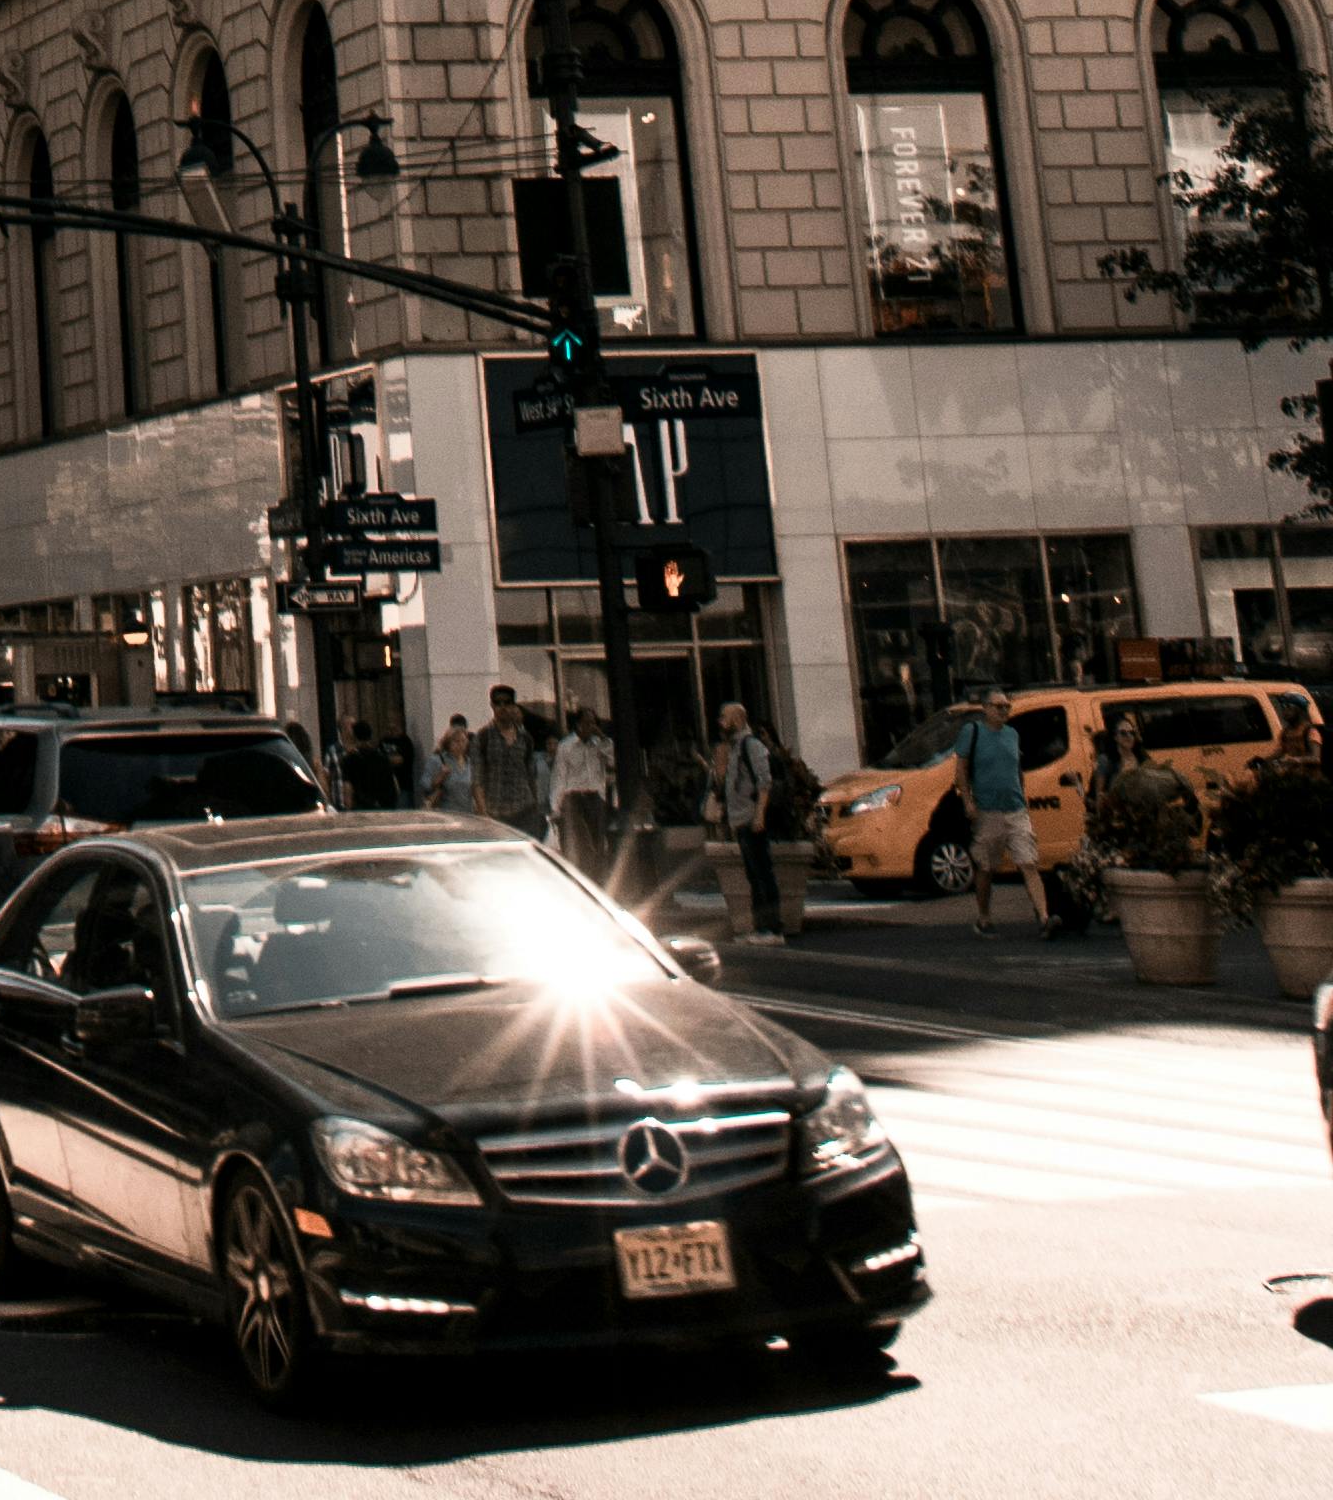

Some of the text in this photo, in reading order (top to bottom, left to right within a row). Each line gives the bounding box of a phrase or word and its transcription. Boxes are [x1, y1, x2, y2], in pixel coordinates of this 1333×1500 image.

[889, 126, 933, 282] FOREVER 21
[639, 386, 740, 411] Sixth Ave
[347, 507, 421, 525] Sixth Ave
[368, 547, 431, 566] Americas
